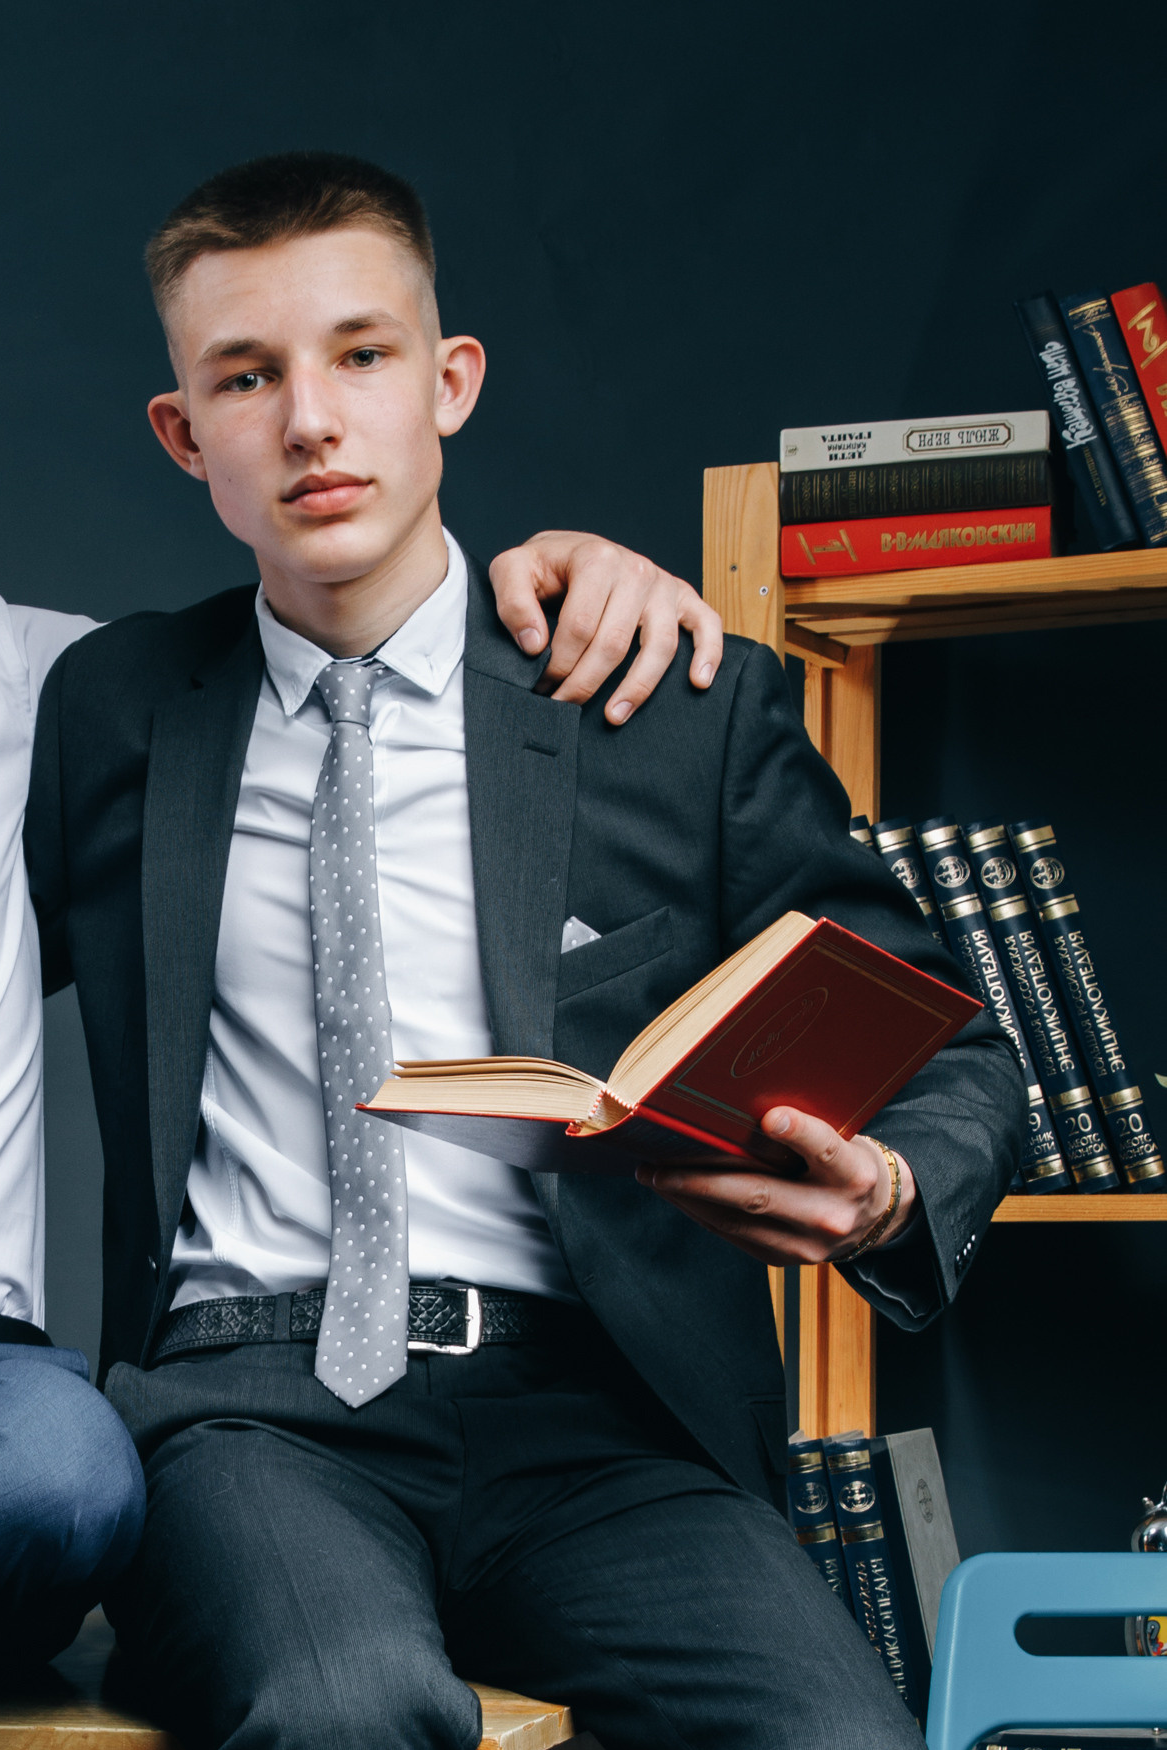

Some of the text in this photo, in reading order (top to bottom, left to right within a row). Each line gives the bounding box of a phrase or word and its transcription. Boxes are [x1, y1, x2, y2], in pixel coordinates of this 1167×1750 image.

[821, 431, 872, 443] ГРАНТА
[918, 428, 1001, 447] ЖЮЛЬ ВЕРН
[828, 449, 866, 462] ДЕТИ
[1004, 935, 1035, 1015] РОССИЙСКАЯ
[1017, 930, 1076, 1073] ЭНЦИКЛОПЕДИЯ
[1068, 930, 1126, 1073] ЭНЦИКЛОПЕДИЯ
[1065, 1112, 1092, 1136] 20
[1117, 1112, 1143, 1136] 20
